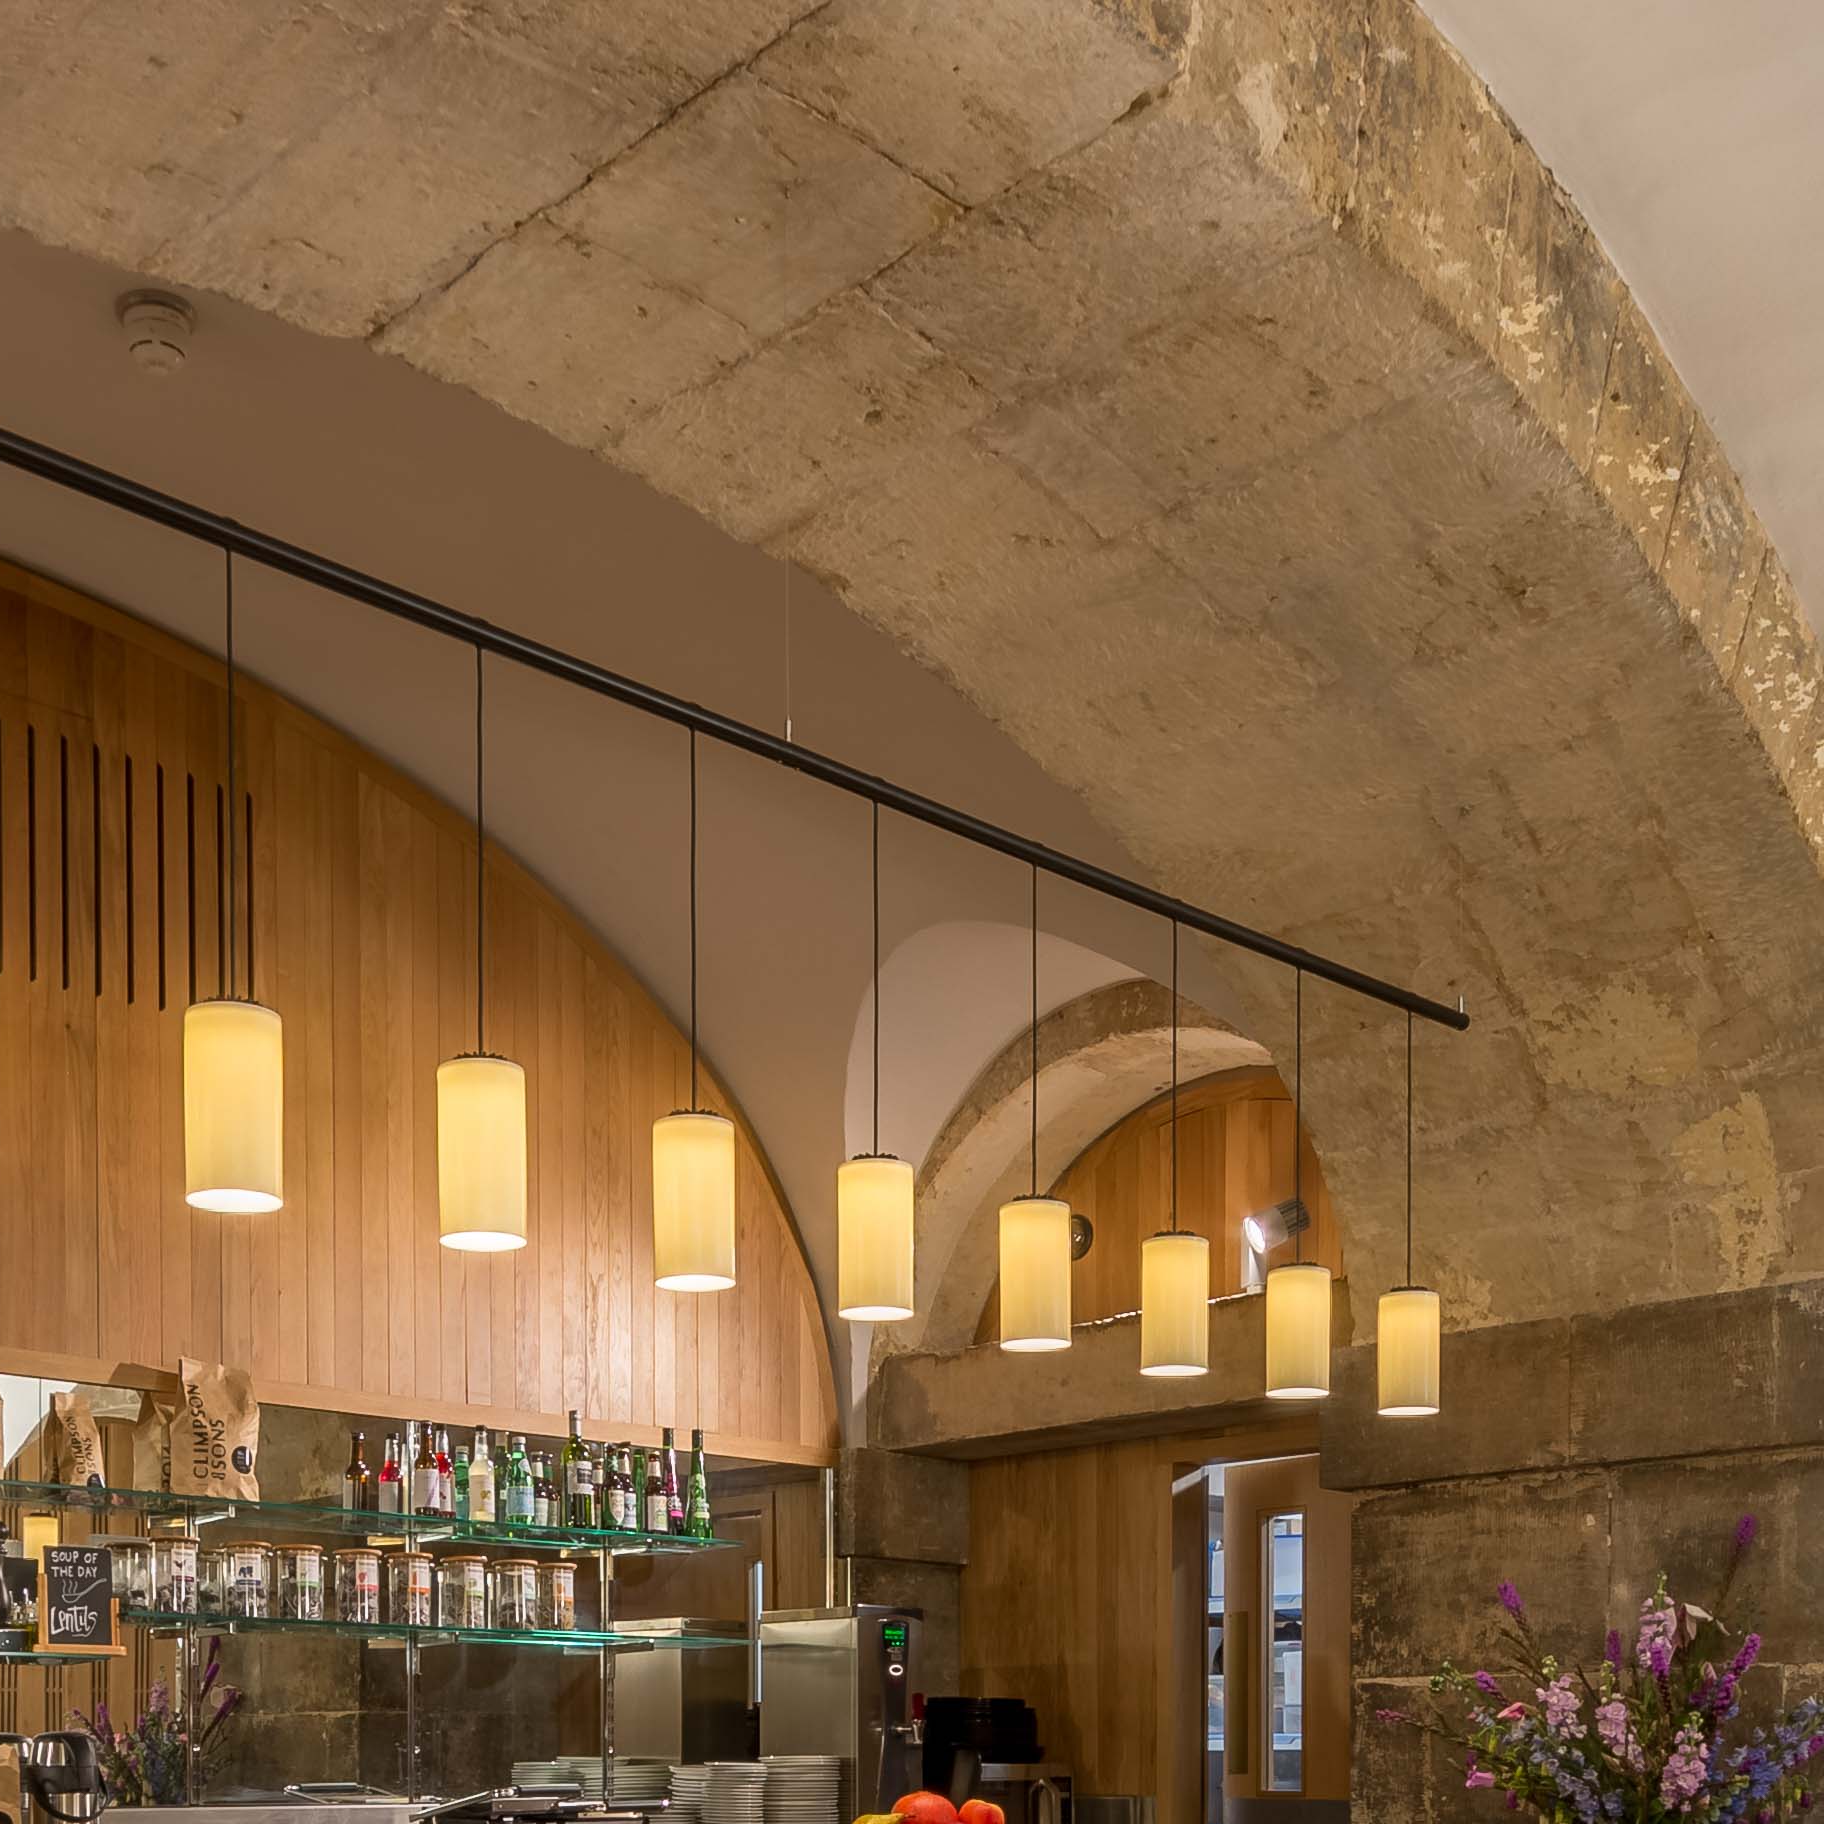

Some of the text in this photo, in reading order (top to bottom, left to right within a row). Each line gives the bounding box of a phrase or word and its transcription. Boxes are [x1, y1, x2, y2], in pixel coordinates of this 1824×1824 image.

[64, 1415, 86, 1474] CLIMPSON
[187, 1384, 209, 1479] CLIMPSON
[50, 1566, 97, 1578] THE DAY
[51, 1551, 98, 1564] SOUP OF
